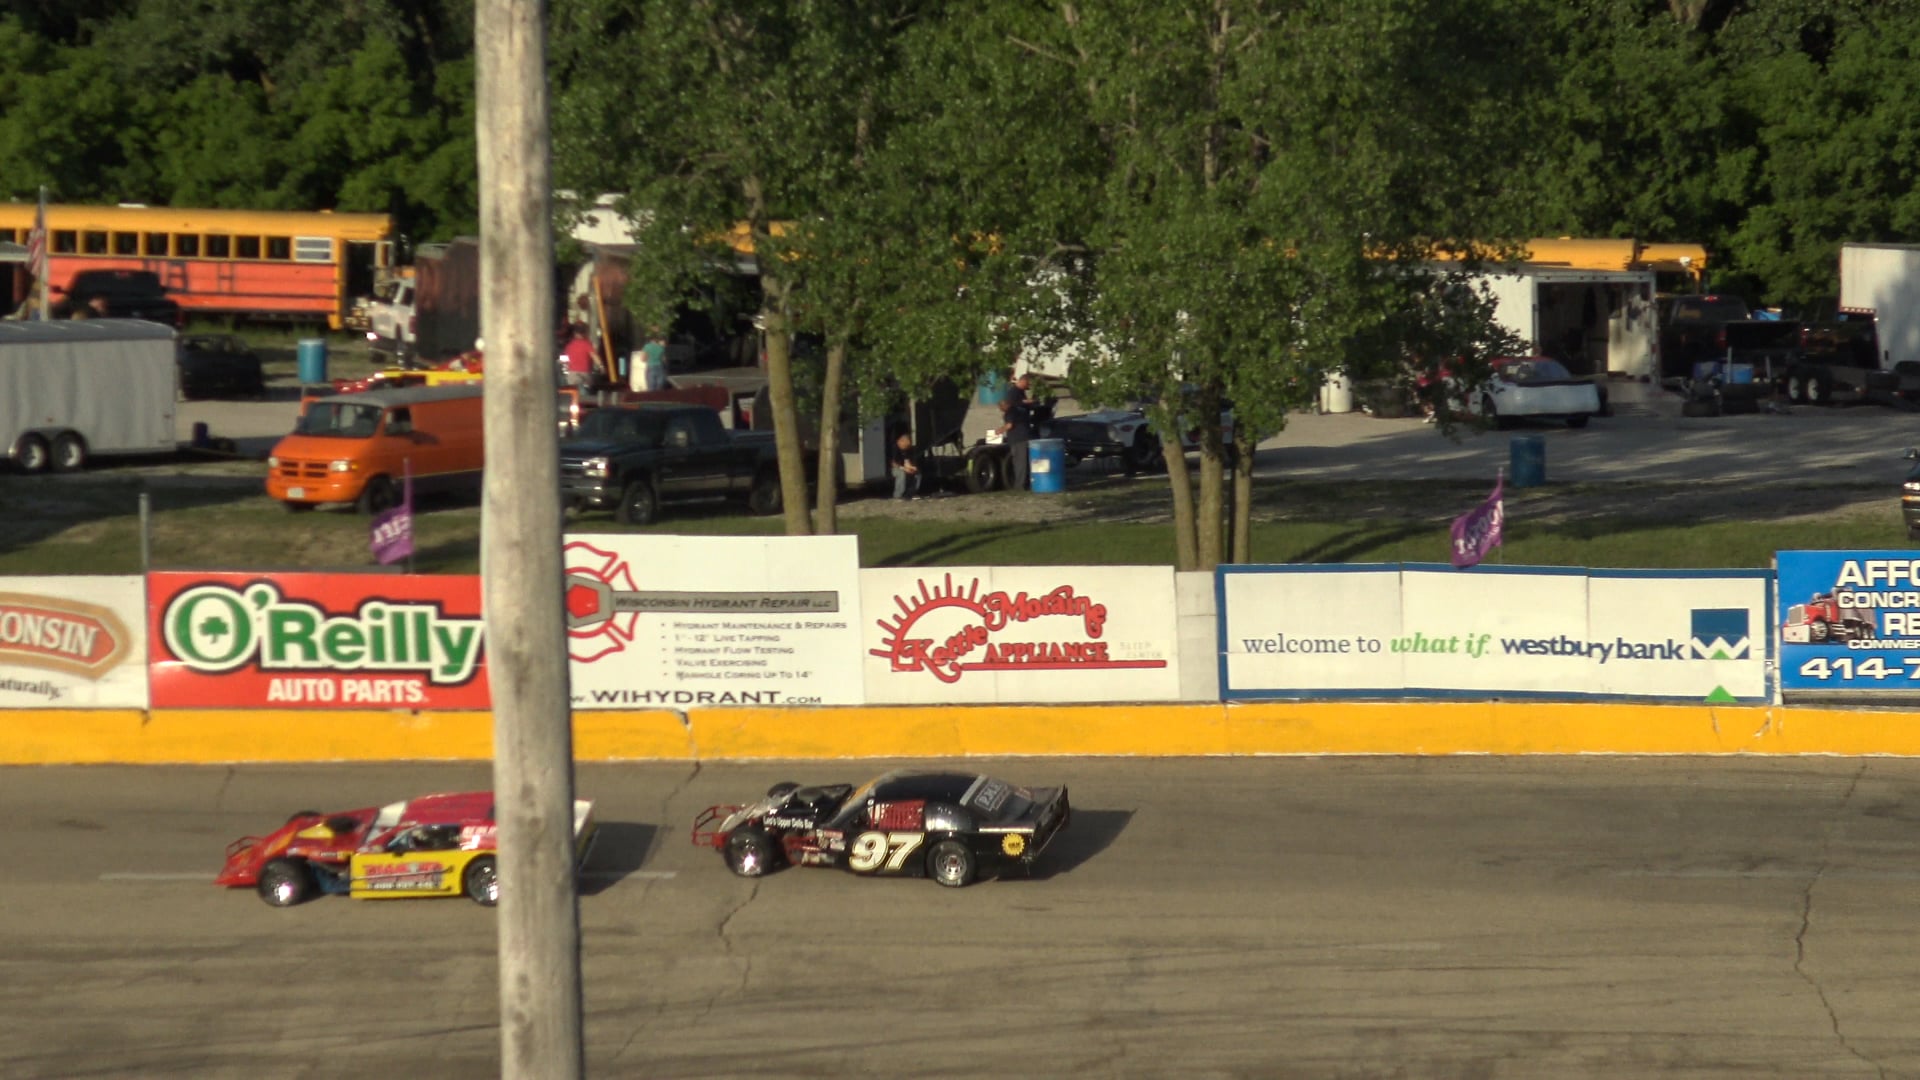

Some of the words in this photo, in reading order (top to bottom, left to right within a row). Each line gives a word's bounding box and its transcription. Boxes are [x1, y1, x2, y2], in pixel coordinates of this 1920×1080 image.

[693, 598, 758, 608] HYDRANT
[760, 597, 810, 608] REPAIR
[0, 611, 100, 657] ONSIN
[166, 585, 481, 680] O'Reilly
[891, 624, 988, 683] Kettle
[984, 585, 1107, 638] Moraine
[1242, 633, 1350, 654] welcome
[1355, 637, 1382, 654] to
[1390, 632, 1460, 654] what
[984, 642, 1109, 662] APPLIANCE
[267, 679, 335, 701] AUTO
[849, 831, 925, 871] 97
